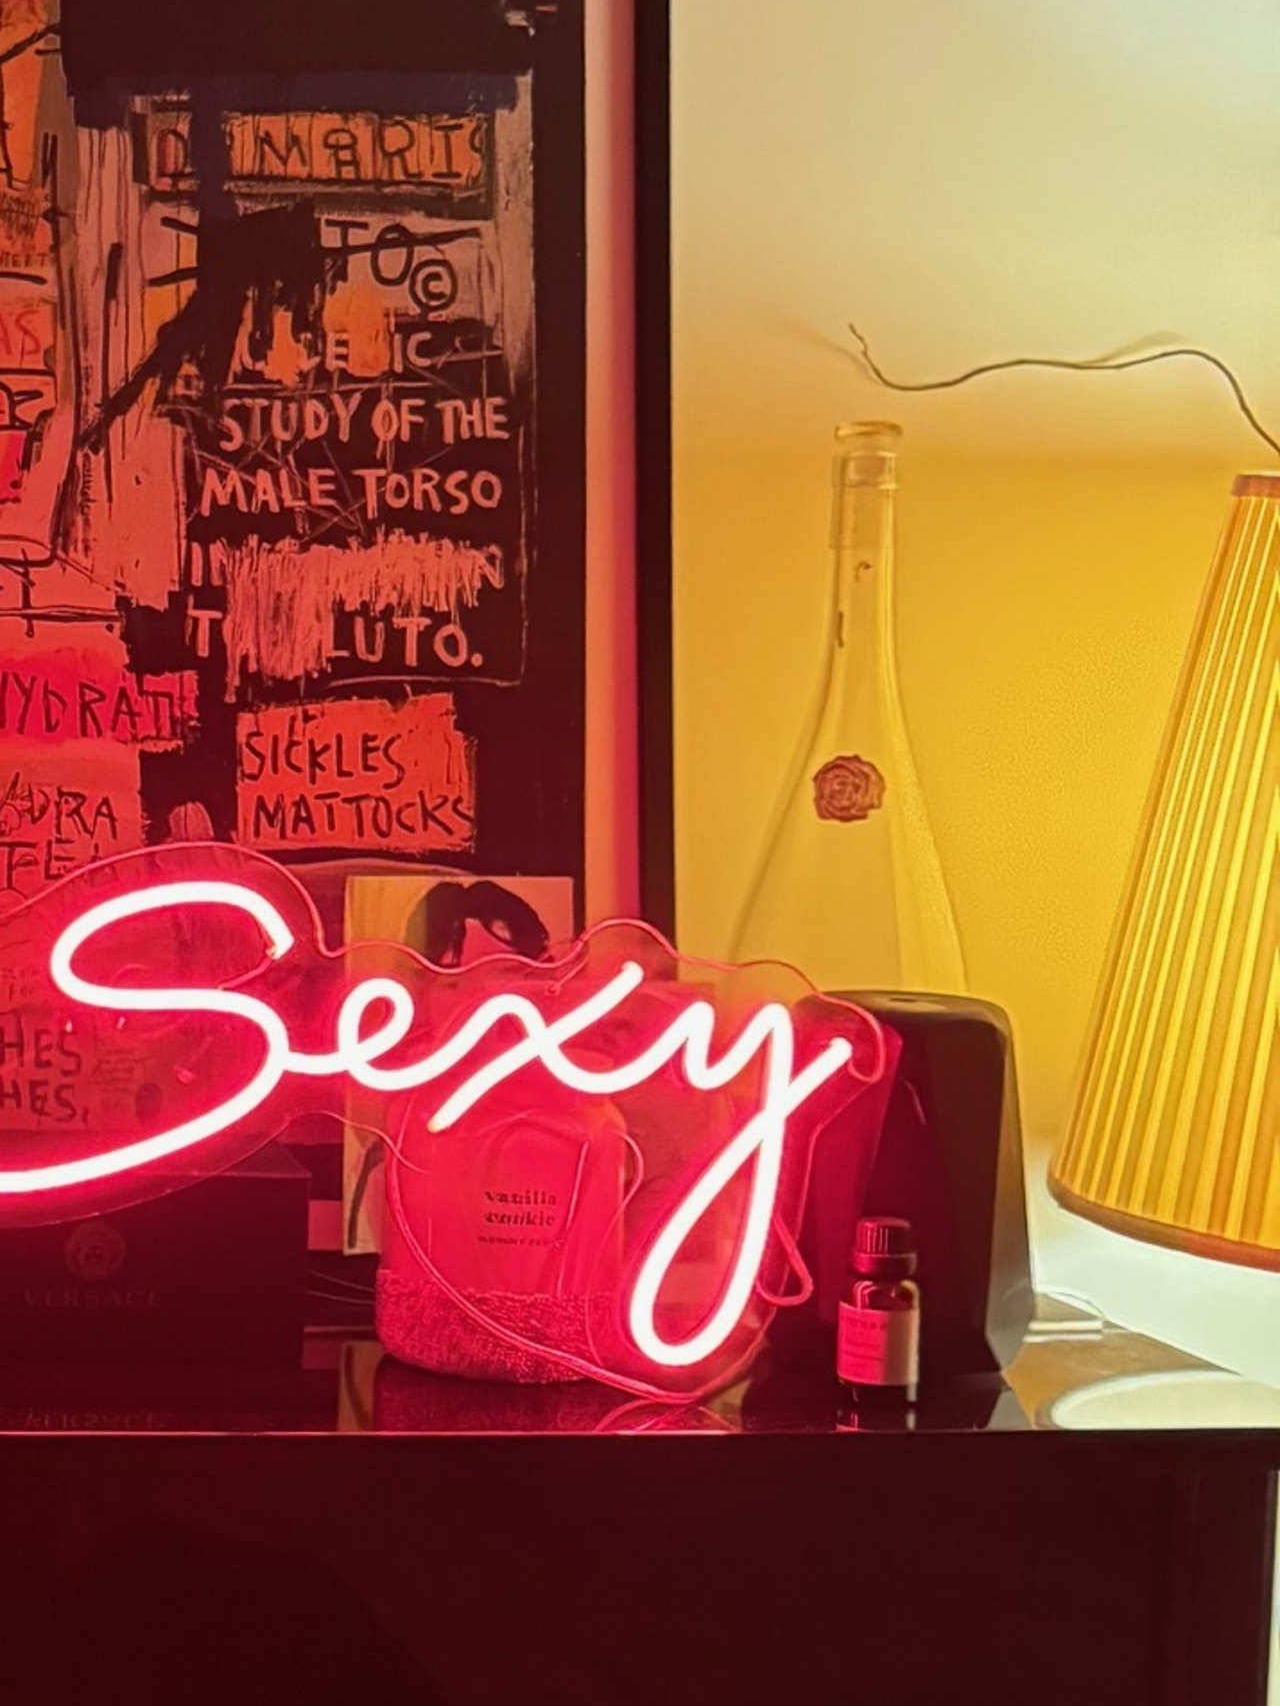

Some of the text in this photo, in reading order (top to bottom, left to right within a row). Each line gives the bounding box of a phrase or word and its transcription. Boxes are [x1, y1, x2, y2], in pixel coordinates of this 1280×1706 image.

[219, 391, 511, 452] STUDY OF THE
[199, 467, 503, 520] MALE TORSO
[242, 731, 406, 791] SICKLES
